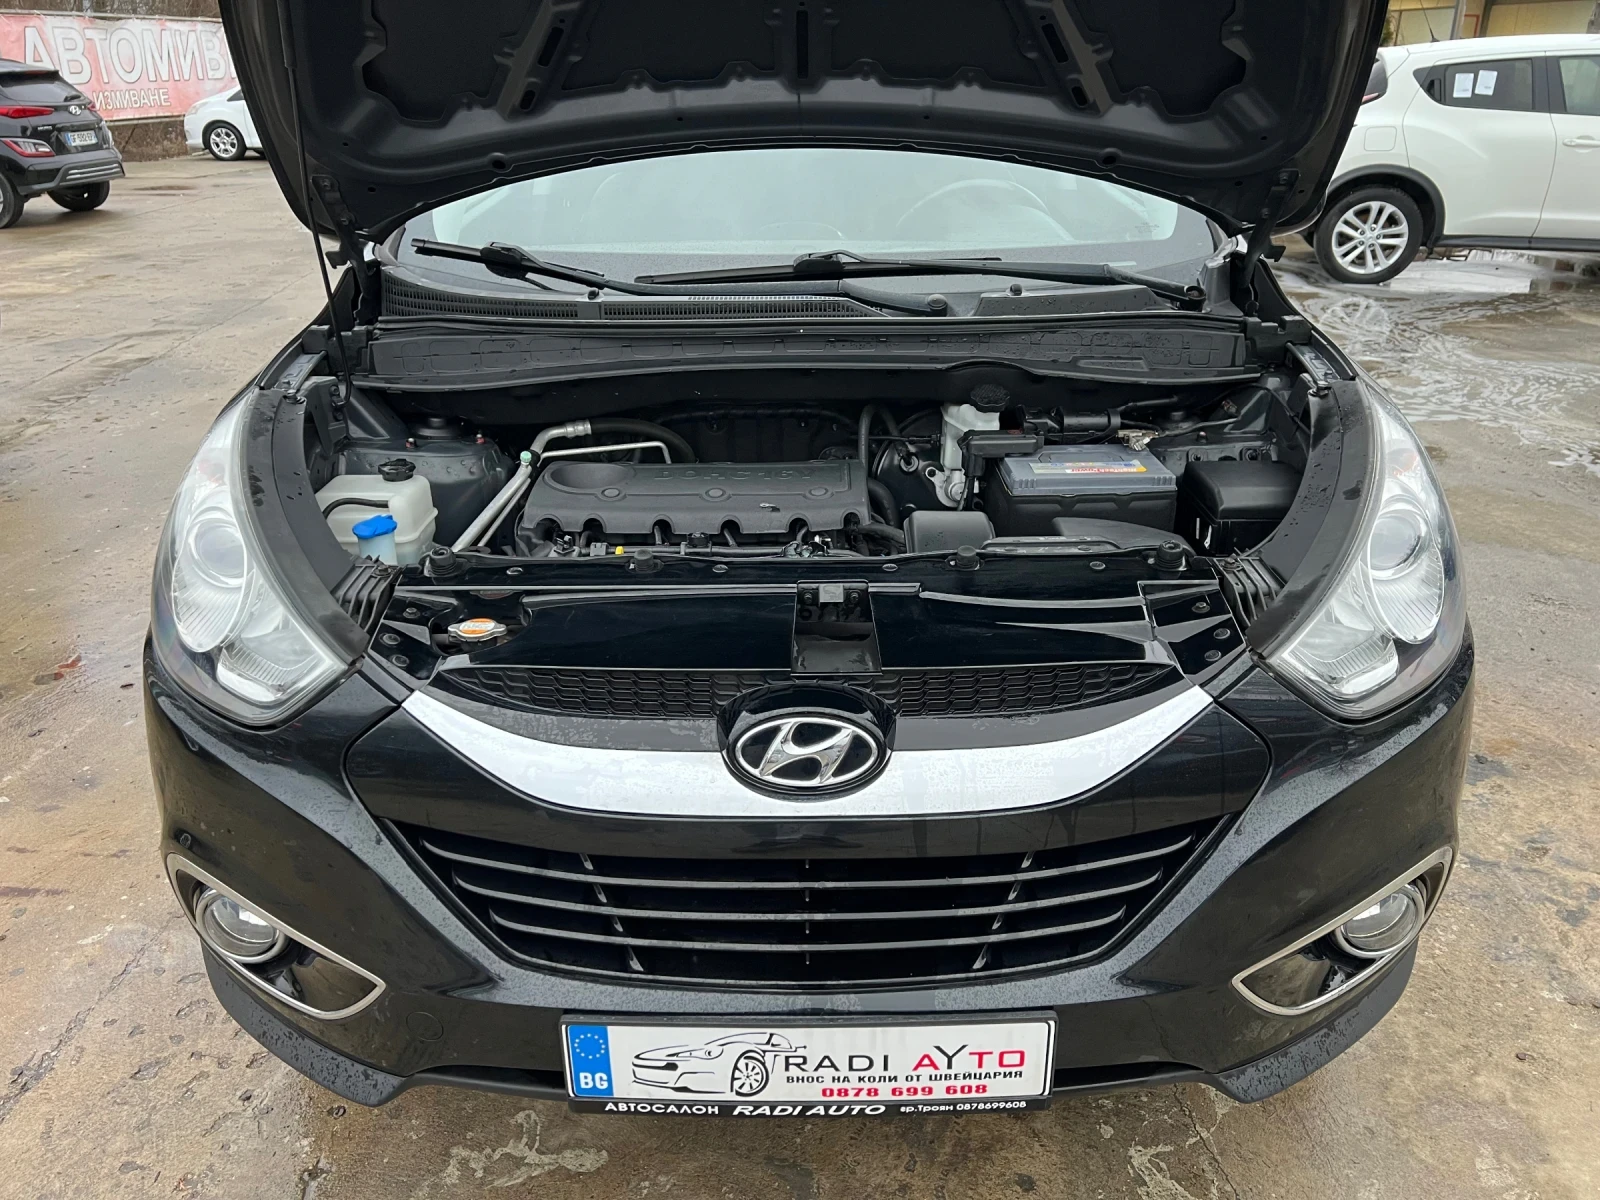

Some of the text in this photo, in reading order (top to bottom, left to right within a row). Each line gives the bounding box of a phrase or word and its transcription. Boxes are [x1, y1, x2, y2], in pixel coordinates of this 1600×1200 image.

[24, 25, 238, 85] АВТОМИВ
[92, 88, 171, 111] ИЗМИВАНЕ
[784, 1054, 889, 1072] RADI
[579, 1072, 609, 1090] BG
[786, 1070, 1023, 1084] ВНОС НА КОЛИ ОТ ШВЕЙЦАРИЯ
[821, 1084, 988, 1098] 0878 699 608
[604, 1102, 720, 1114] АВТОСАЛОН
[732, 1104, 887, 1116] RADI AUTO
[956, 1100, 1027, 1111] 0878699608
